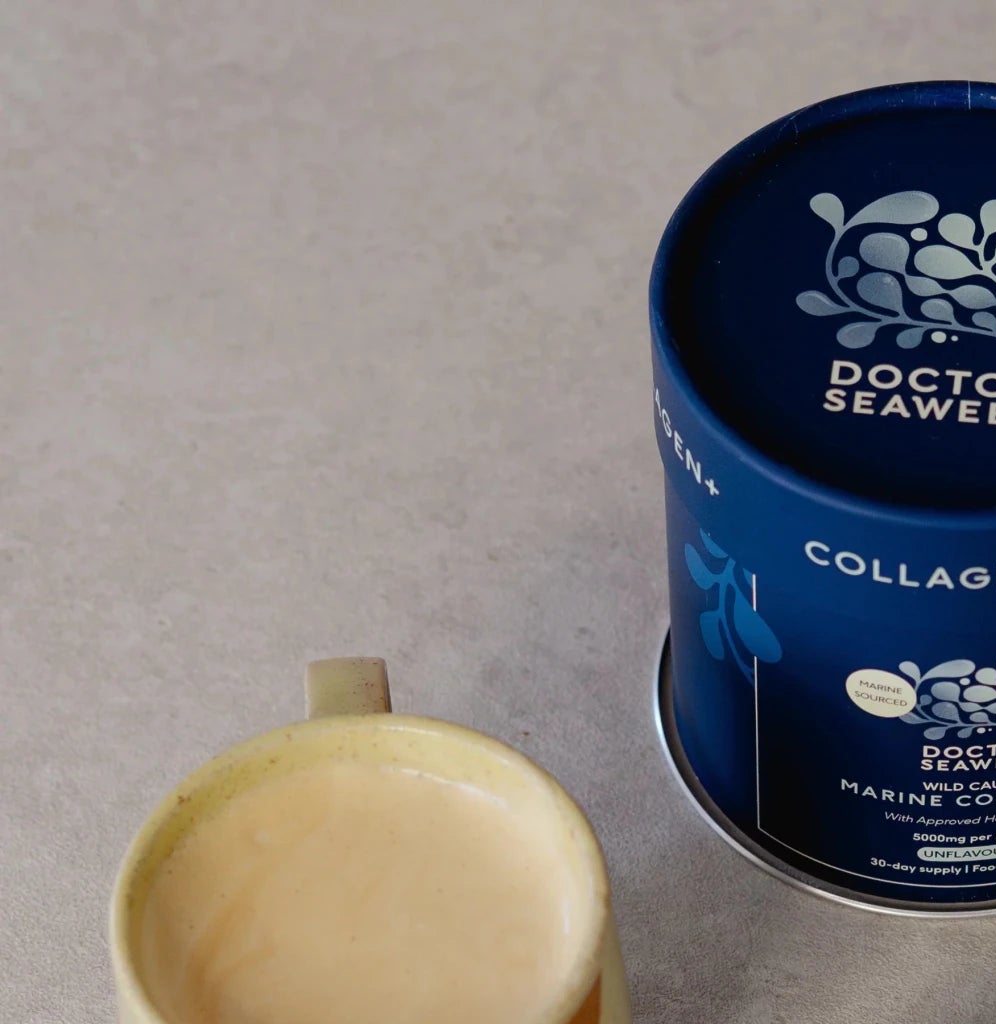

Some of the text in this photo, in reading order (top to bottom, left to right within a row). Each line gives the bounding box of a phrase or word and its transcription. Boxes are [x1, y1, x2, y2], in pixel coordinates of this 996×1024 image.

[859, 680, 903, 695] MARINE
[854, 690, 908, 707] SOURCED
[840, 778, 943, 807] MARINE
[923, 781, 964, 792] WILD
[884, 811, 914, 824] With
[916, 815, 981, 828] Approved
[913, 833, 966, 845] 5000mg
[970, 834, 992, 845] per
[870, 857, 916, 874] 30-day
[919, 864, 962, 876] supply
